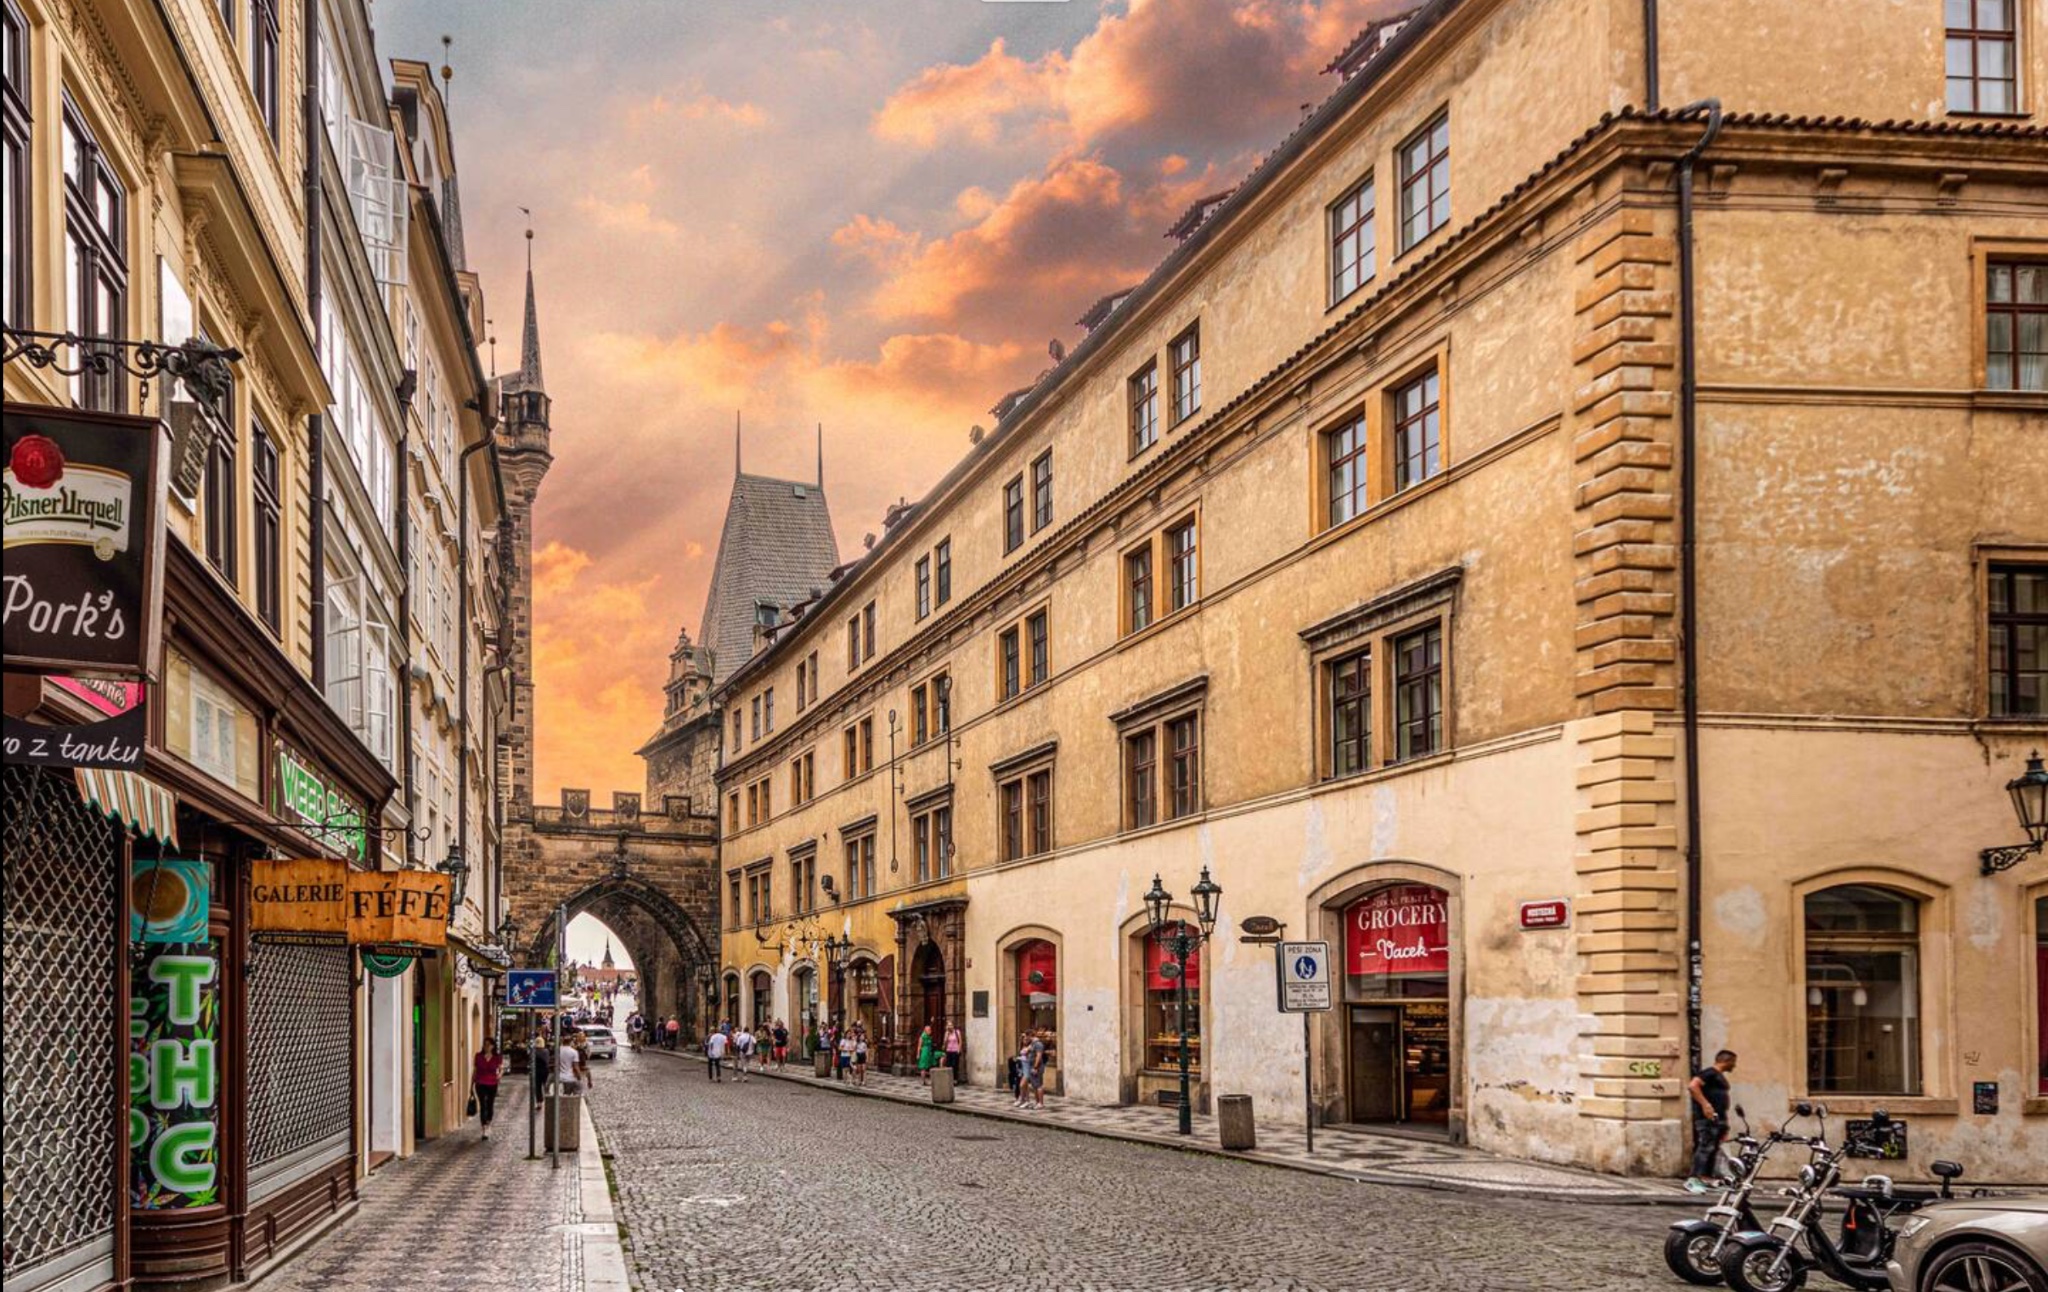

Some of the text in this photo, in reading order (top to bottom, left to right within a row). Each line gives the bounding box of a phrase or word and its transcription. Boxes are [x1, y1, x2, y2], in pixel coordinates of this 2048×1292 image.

[60, 486, 122, 530] Urquell
[60, 733, 140, 764] tanku
[280, 752, 326, 827] WEED
[253, 883, 344, 904] GALERIE
[1358, 903, 1448, 931] GROCERY
[1376, 936, 1428, 960] Vacek
